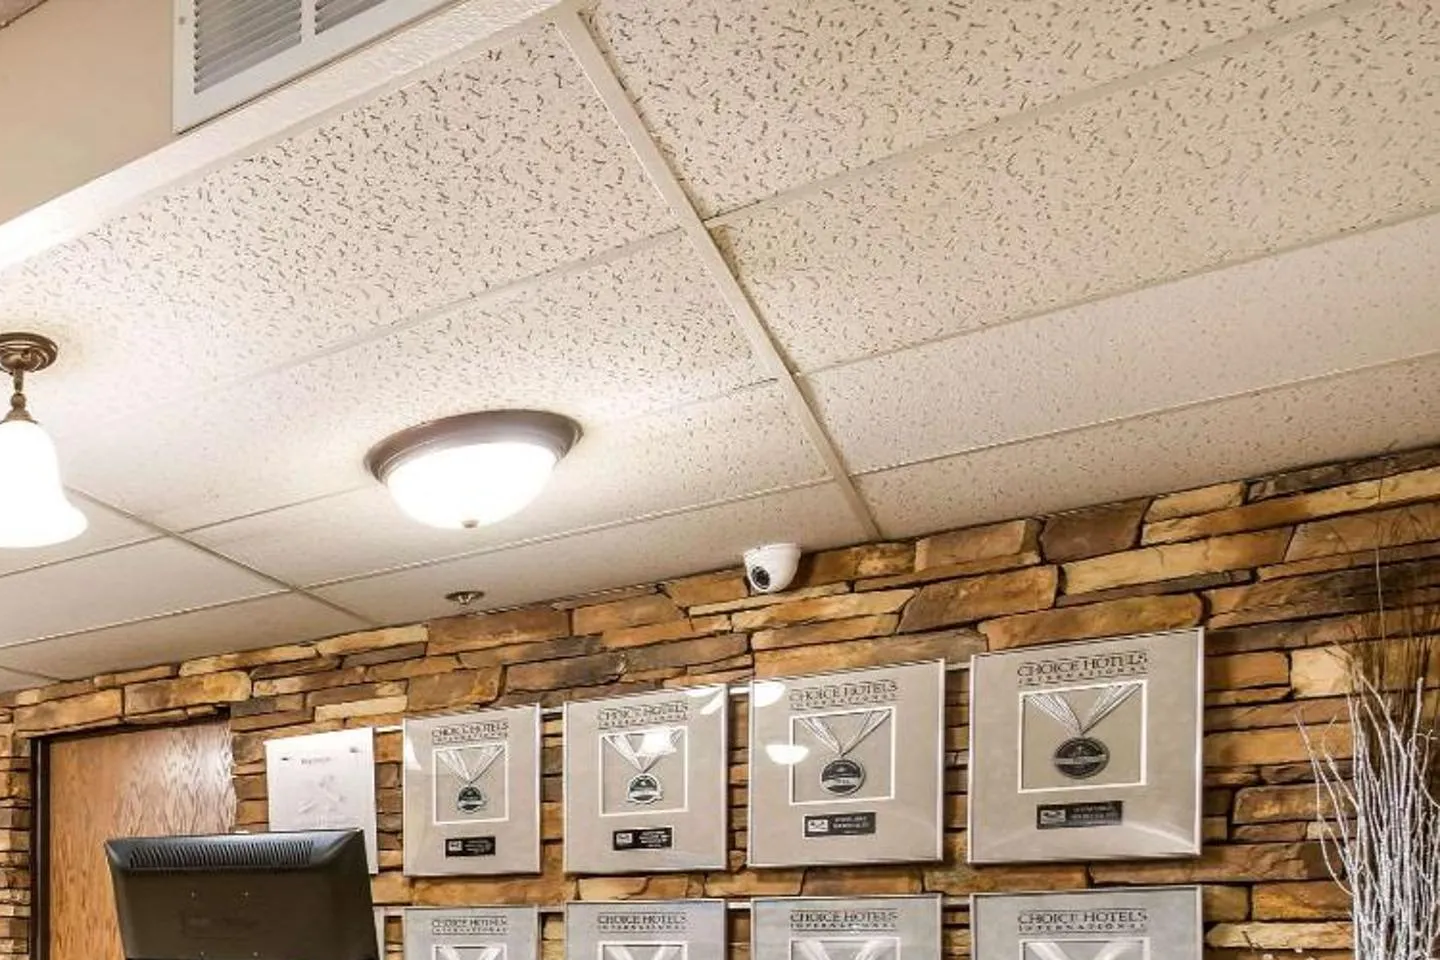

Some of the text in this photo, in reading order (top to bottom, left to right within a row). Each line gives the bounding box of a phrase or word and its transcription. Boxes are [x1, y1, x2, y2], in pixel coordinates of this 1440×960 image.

[790, 911, 898, 922] CHOICE HOTELS
[1017, 911, 1148, 925] CHOICE HOTELS
